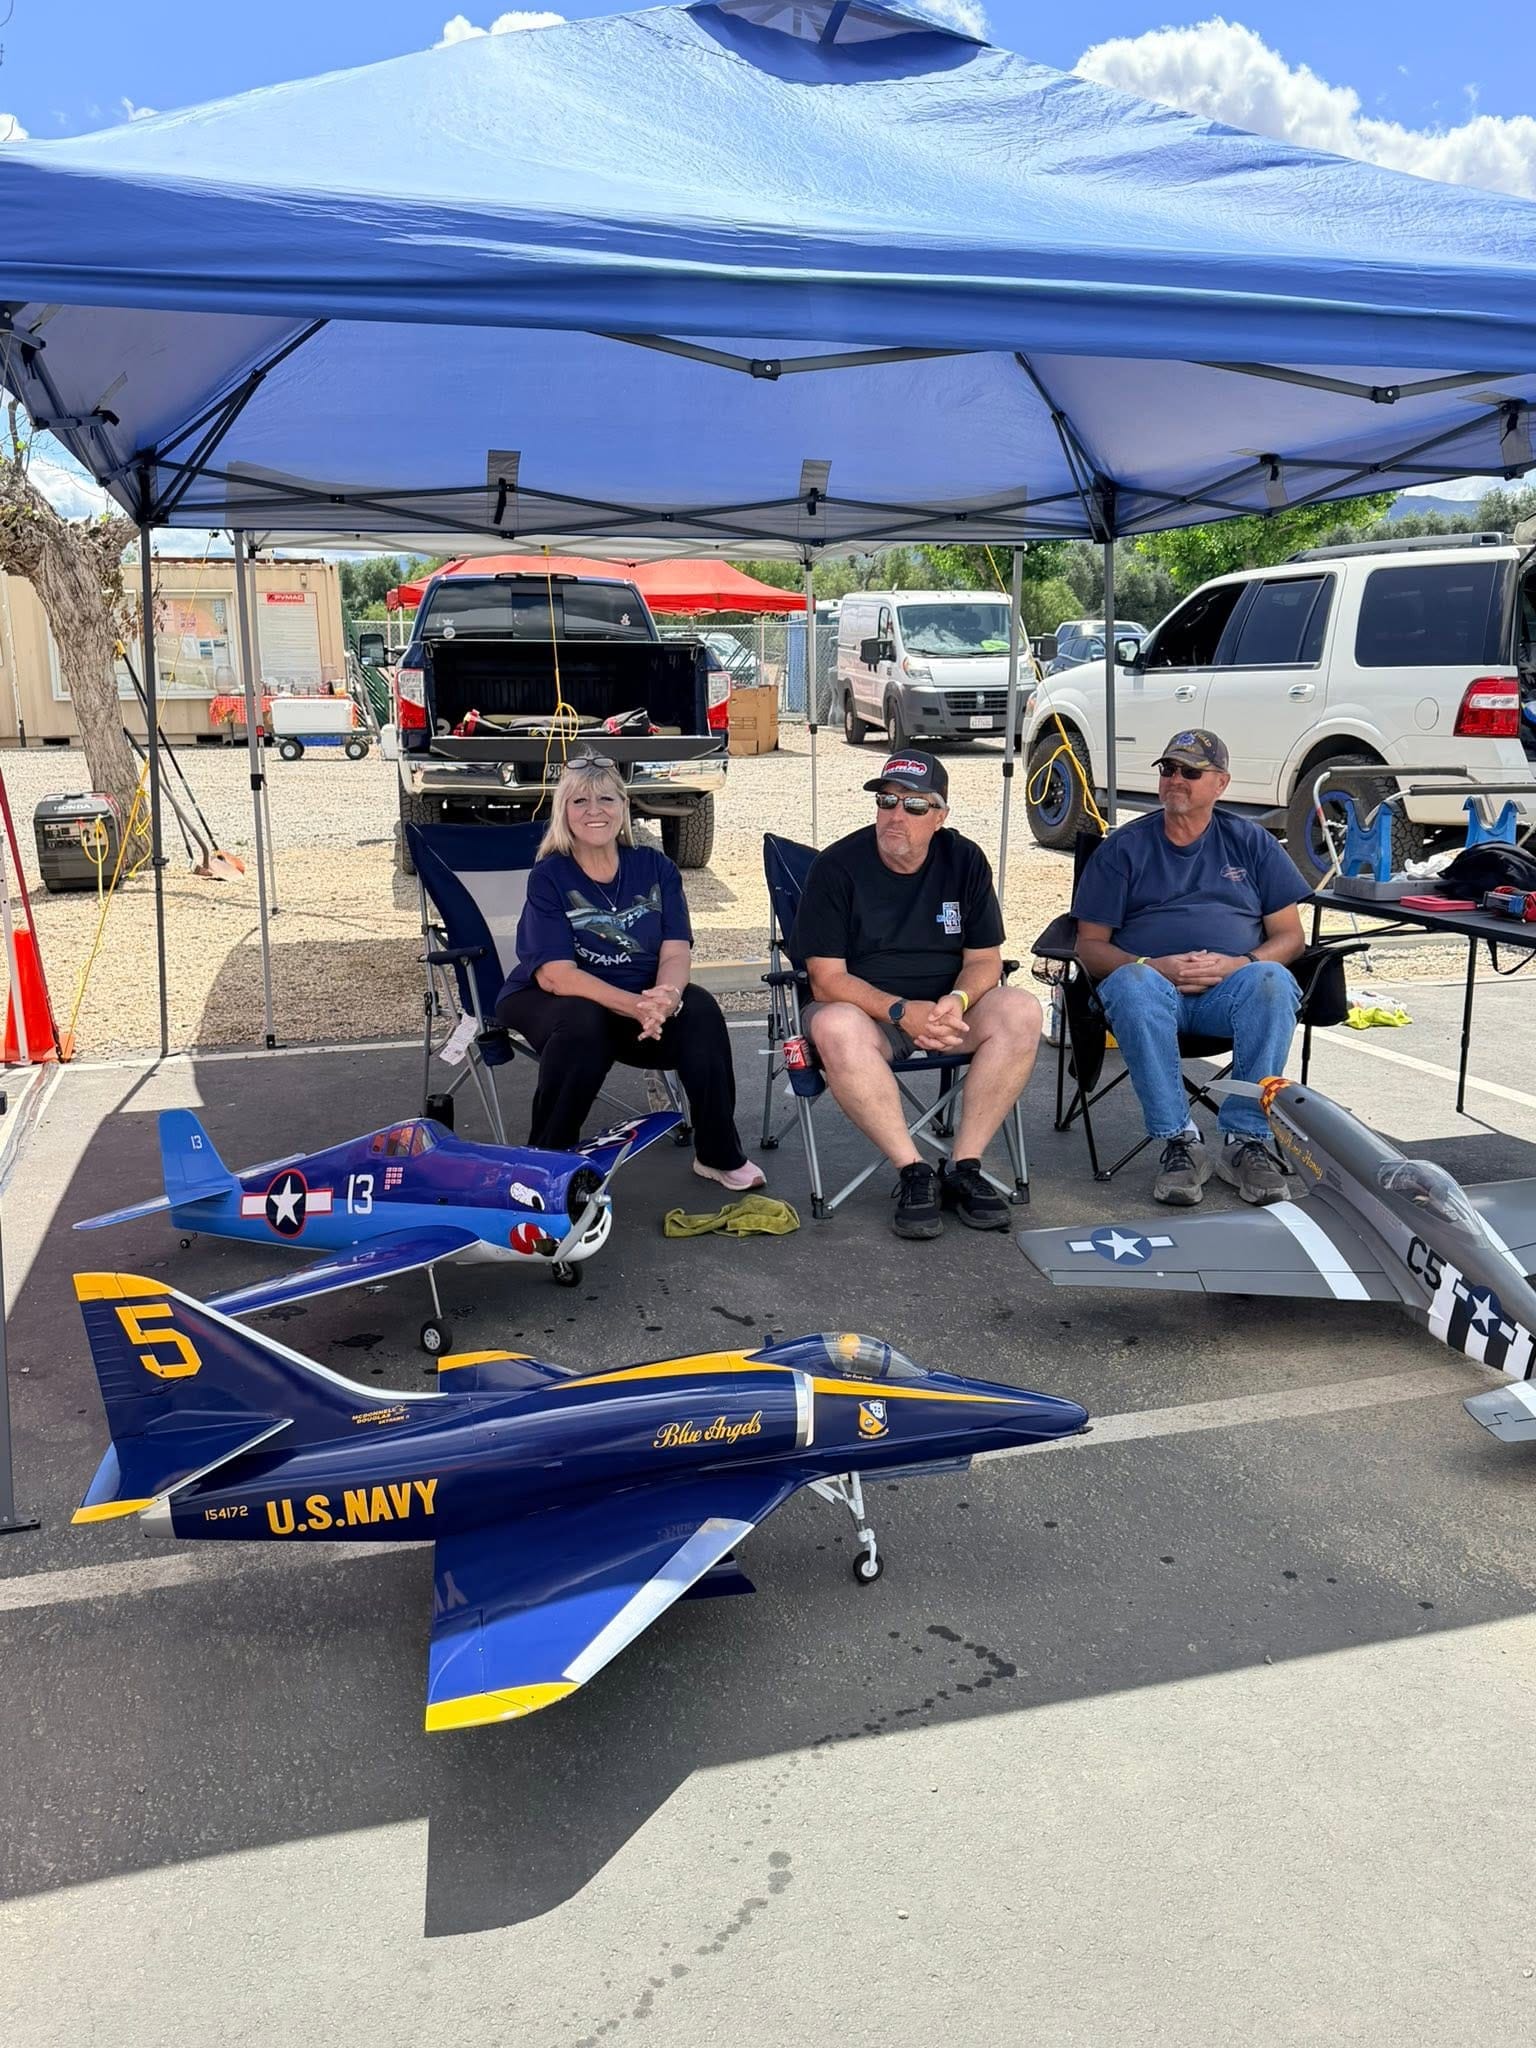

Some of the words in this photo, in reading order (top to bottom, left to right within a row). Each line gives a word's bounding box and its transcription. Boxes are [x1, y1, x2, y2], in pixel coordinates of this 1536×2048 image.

[53, 803, 92, 811] HONDA
[574, 938, 632, 966] STANG
[190, 1135, 203, 1150] 13
[347, 1174, 375, 1215] 13
[114, 1302, 203, 1379] 5
[653, 1420, 702, 1448] Blue
[704, 1410, 763, 1445] Angels
[204, 1505, 249, 1521] 154172
